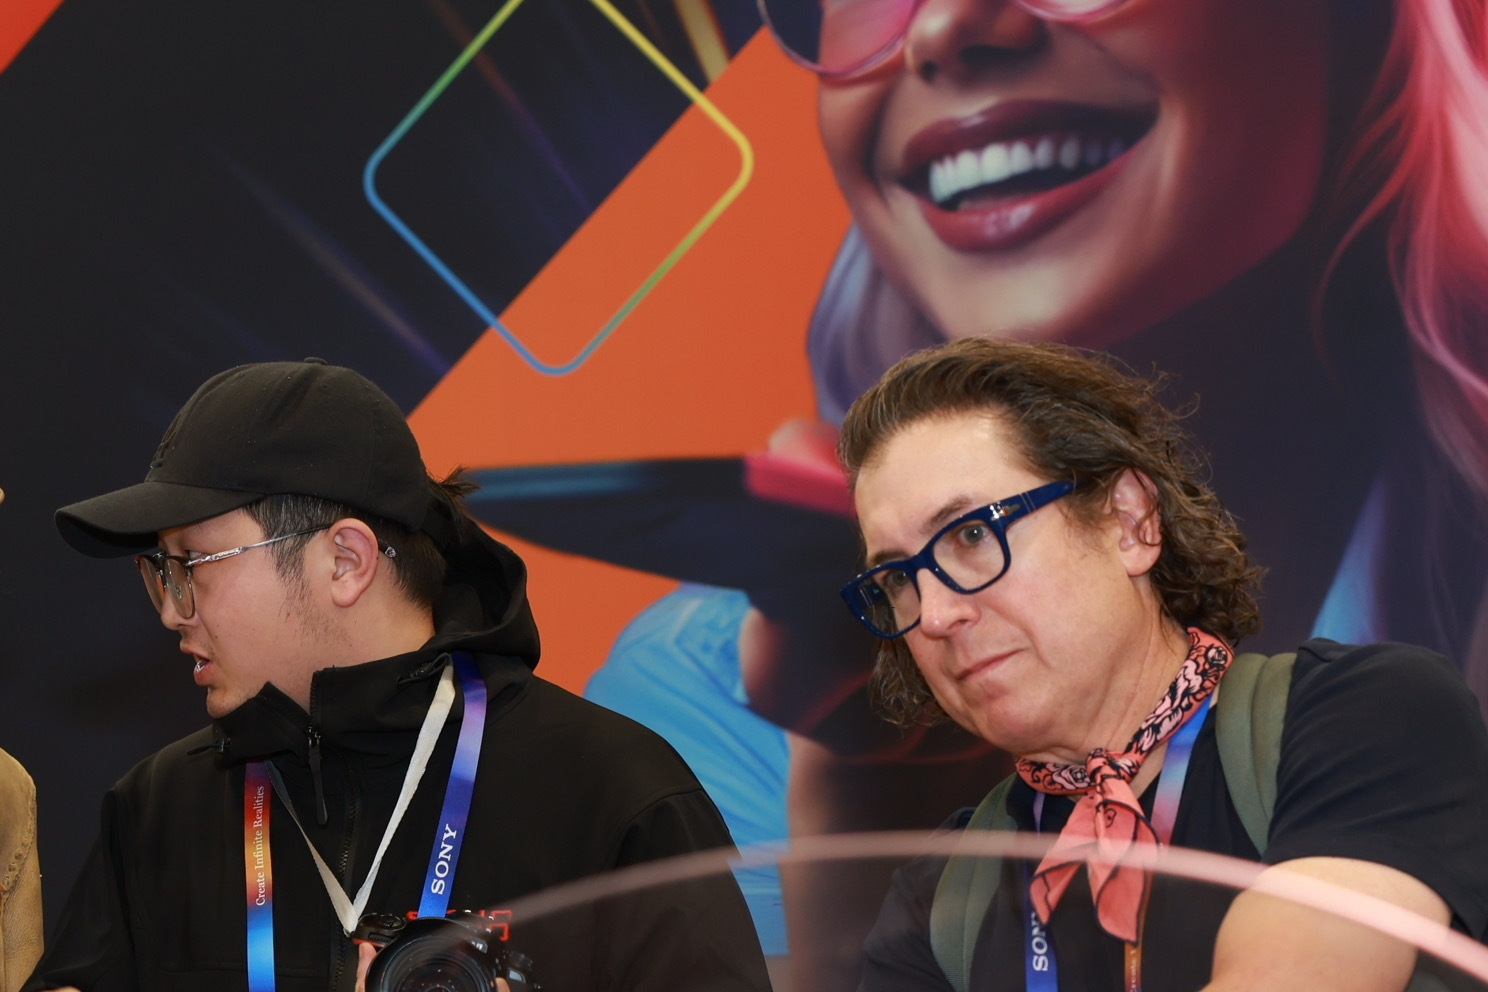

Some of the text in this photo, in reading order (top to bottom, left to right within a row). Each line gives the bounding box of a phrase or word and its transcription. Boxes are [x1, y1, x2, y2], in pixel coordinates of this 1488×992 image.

[253, 786, 266, 906] Create Infinite Realities
[431, 823, 457, 895] SONY
